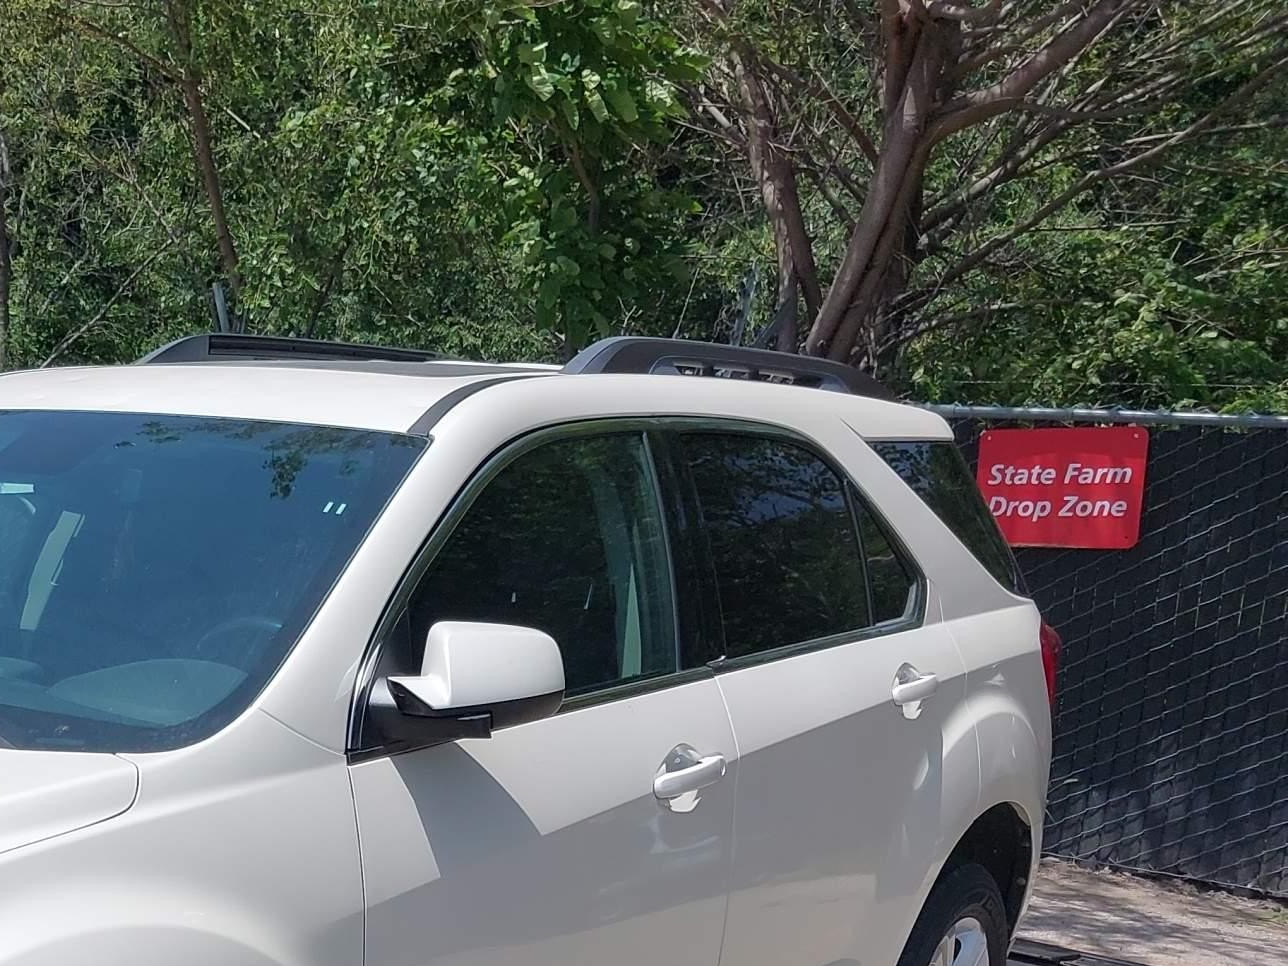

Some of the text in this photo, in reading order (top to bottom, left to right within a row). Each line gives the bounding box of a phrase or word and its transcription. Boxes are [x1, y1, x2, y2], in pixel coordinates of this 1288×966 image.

[987, 463, 1132, 485] State Farm
[989, 496, 1127, 522] Drop Zone
